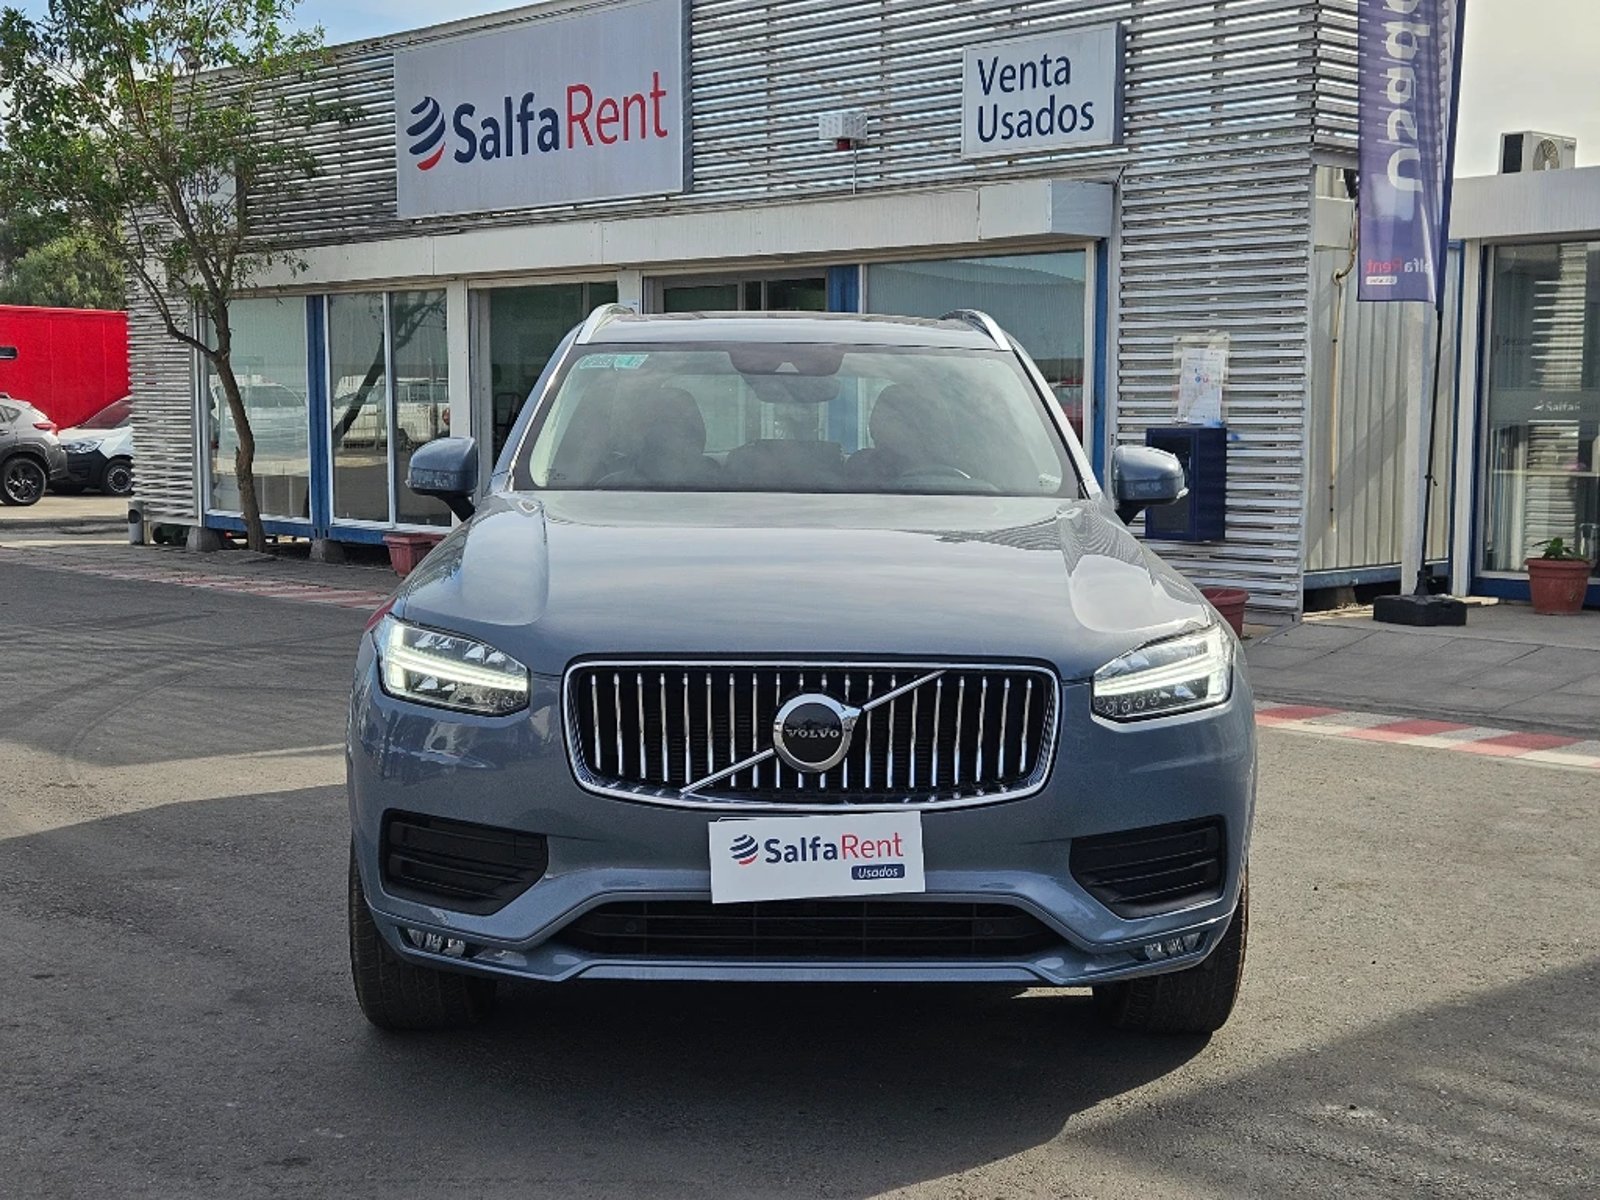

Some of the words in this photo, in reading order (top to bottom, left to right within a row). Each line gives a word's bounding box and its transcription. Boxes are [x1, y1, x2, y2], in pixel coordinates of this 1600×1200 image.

[977, 53, 1071, 96] Venta
[452, 71, 668, 164] SalfaRent
[977, 94, 1095, 143] Usados
[785, 728, 840, 739] VOLVO
[764, 832, 904, 864] SalfaRent
[857, 866, 899, 879] Usados
